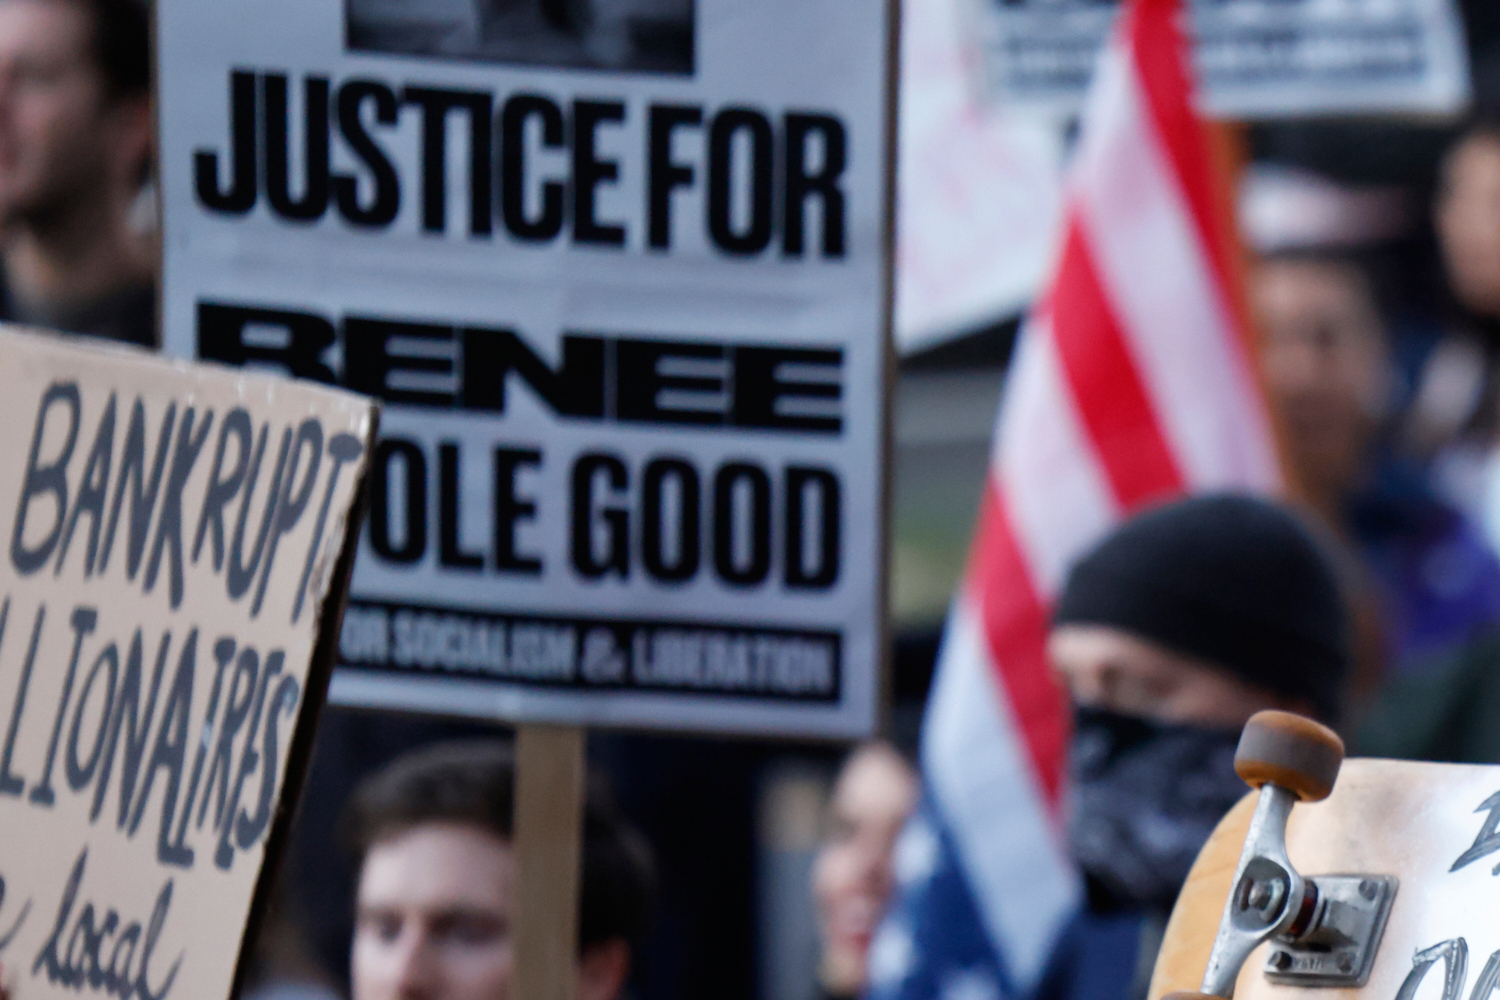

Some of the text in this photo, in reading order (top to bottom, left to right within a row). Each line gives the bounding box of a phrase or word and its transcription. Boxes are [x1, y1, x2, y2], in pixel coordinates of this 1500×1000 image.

[193, 69, 846, 259] JUSTICE FOR
[197, 302, 843, 433] RENEE
[10, 378, 364, 626] BANKRUPT
[367, 439, 842, 593] OLE GOOD
[0, 592, 300, 870] LIONAIRES
[339, 606, 834, 695] OR SOCIALISM & LIBERATION
